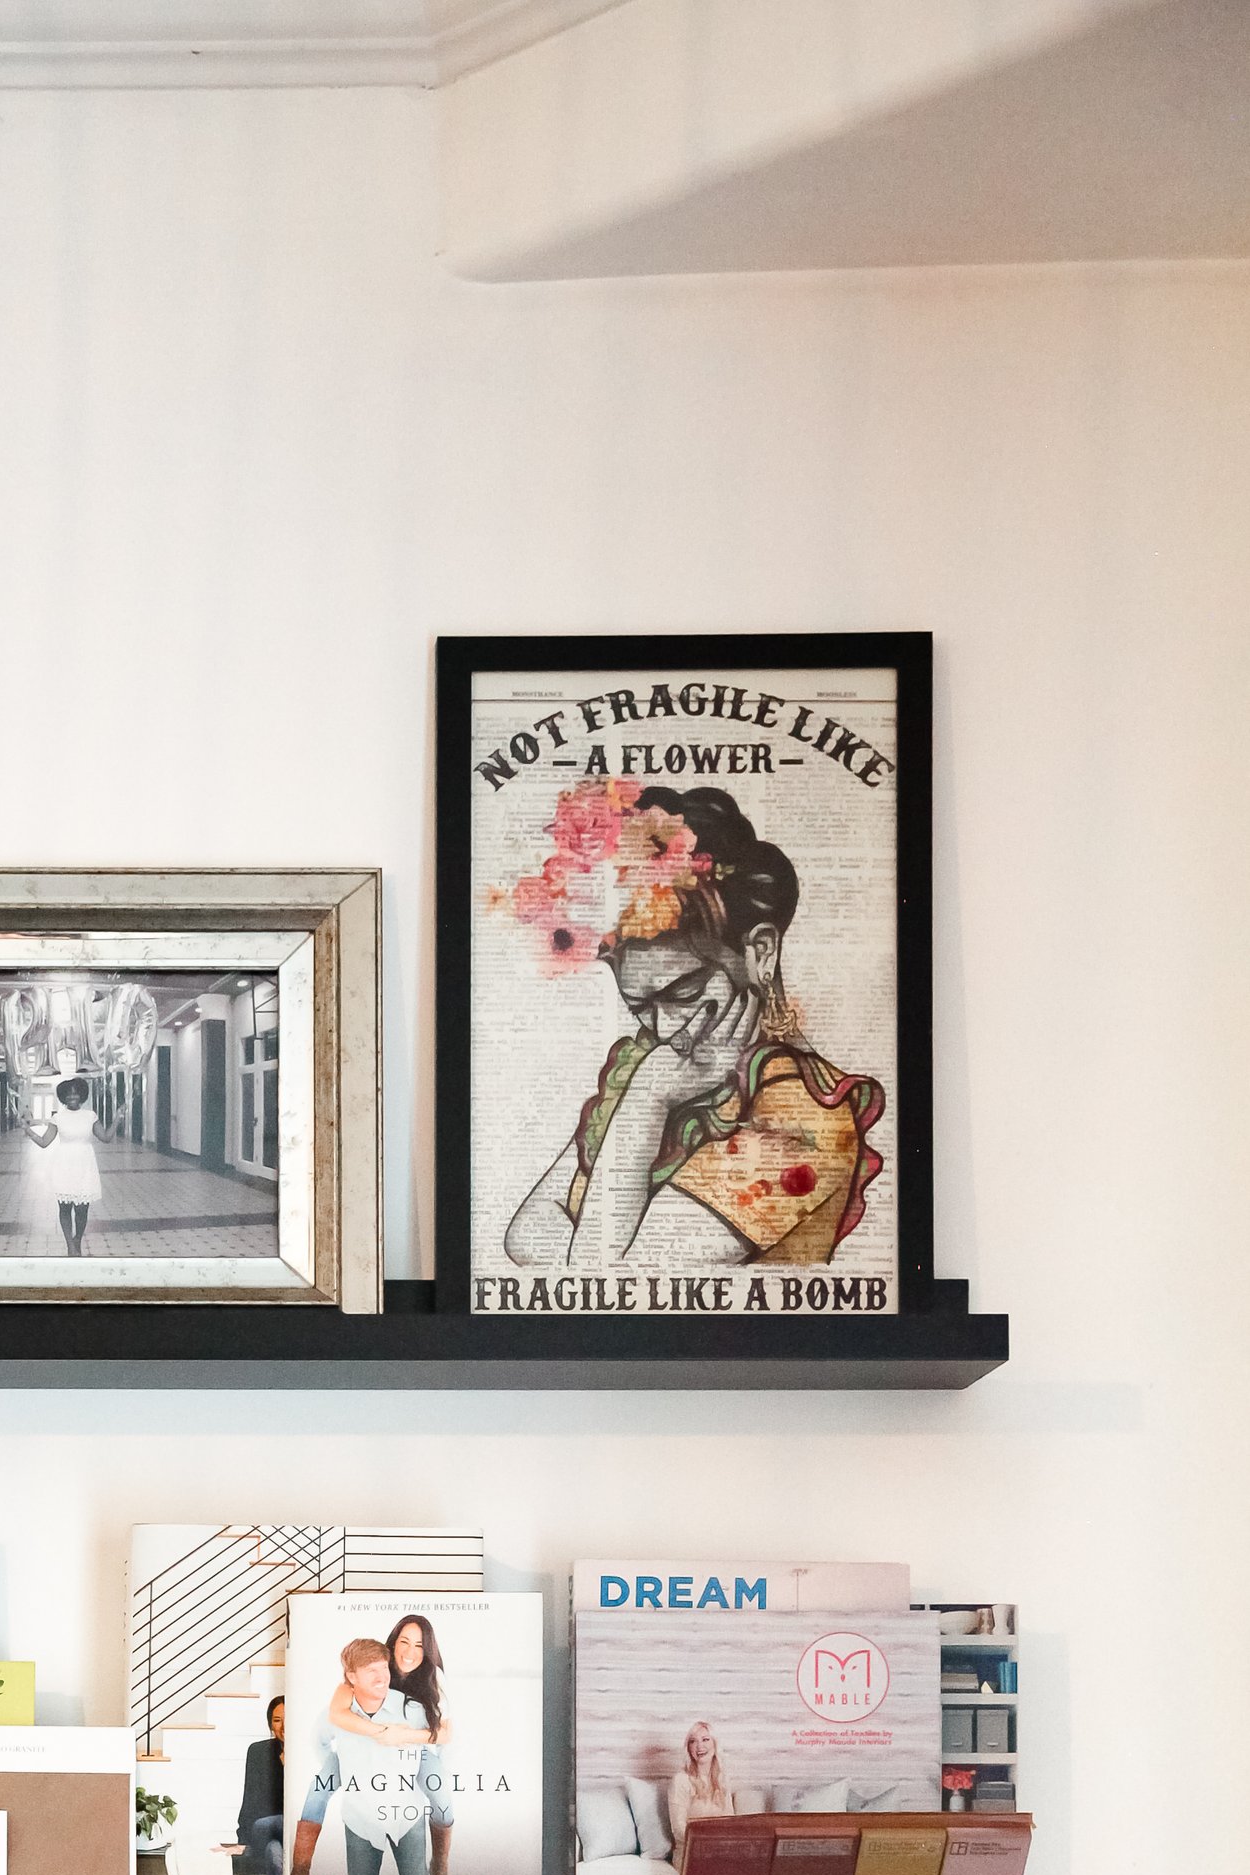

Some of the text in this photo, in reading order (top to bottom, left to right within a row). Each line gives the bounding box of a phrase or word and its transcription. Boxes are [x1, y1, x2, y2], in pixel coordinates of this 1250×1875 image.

[473, 682, 897, 792] NOT FRAGILE LIKE
[586, 743, 776, 775] A FLOWER
[474, 1277, 888, 1312] FRAGILE LIKE A BOMB
[600, 1575, 767, 1610] DREAM
[350, 1603, 371, 1611] NEW
[374, 1603, 400, 1611] YORK
[403, 1603, 431, 1611] TIMES
[434, 1603, 490, 1611] BESTSELLER
[814, 1693, 871, 1706] MABLE
[398, 1749, 428, 1761] THE
[314, 1773, 512, 1792] MAGNOLIA
[377, 1805, 449, 1821] STORY
